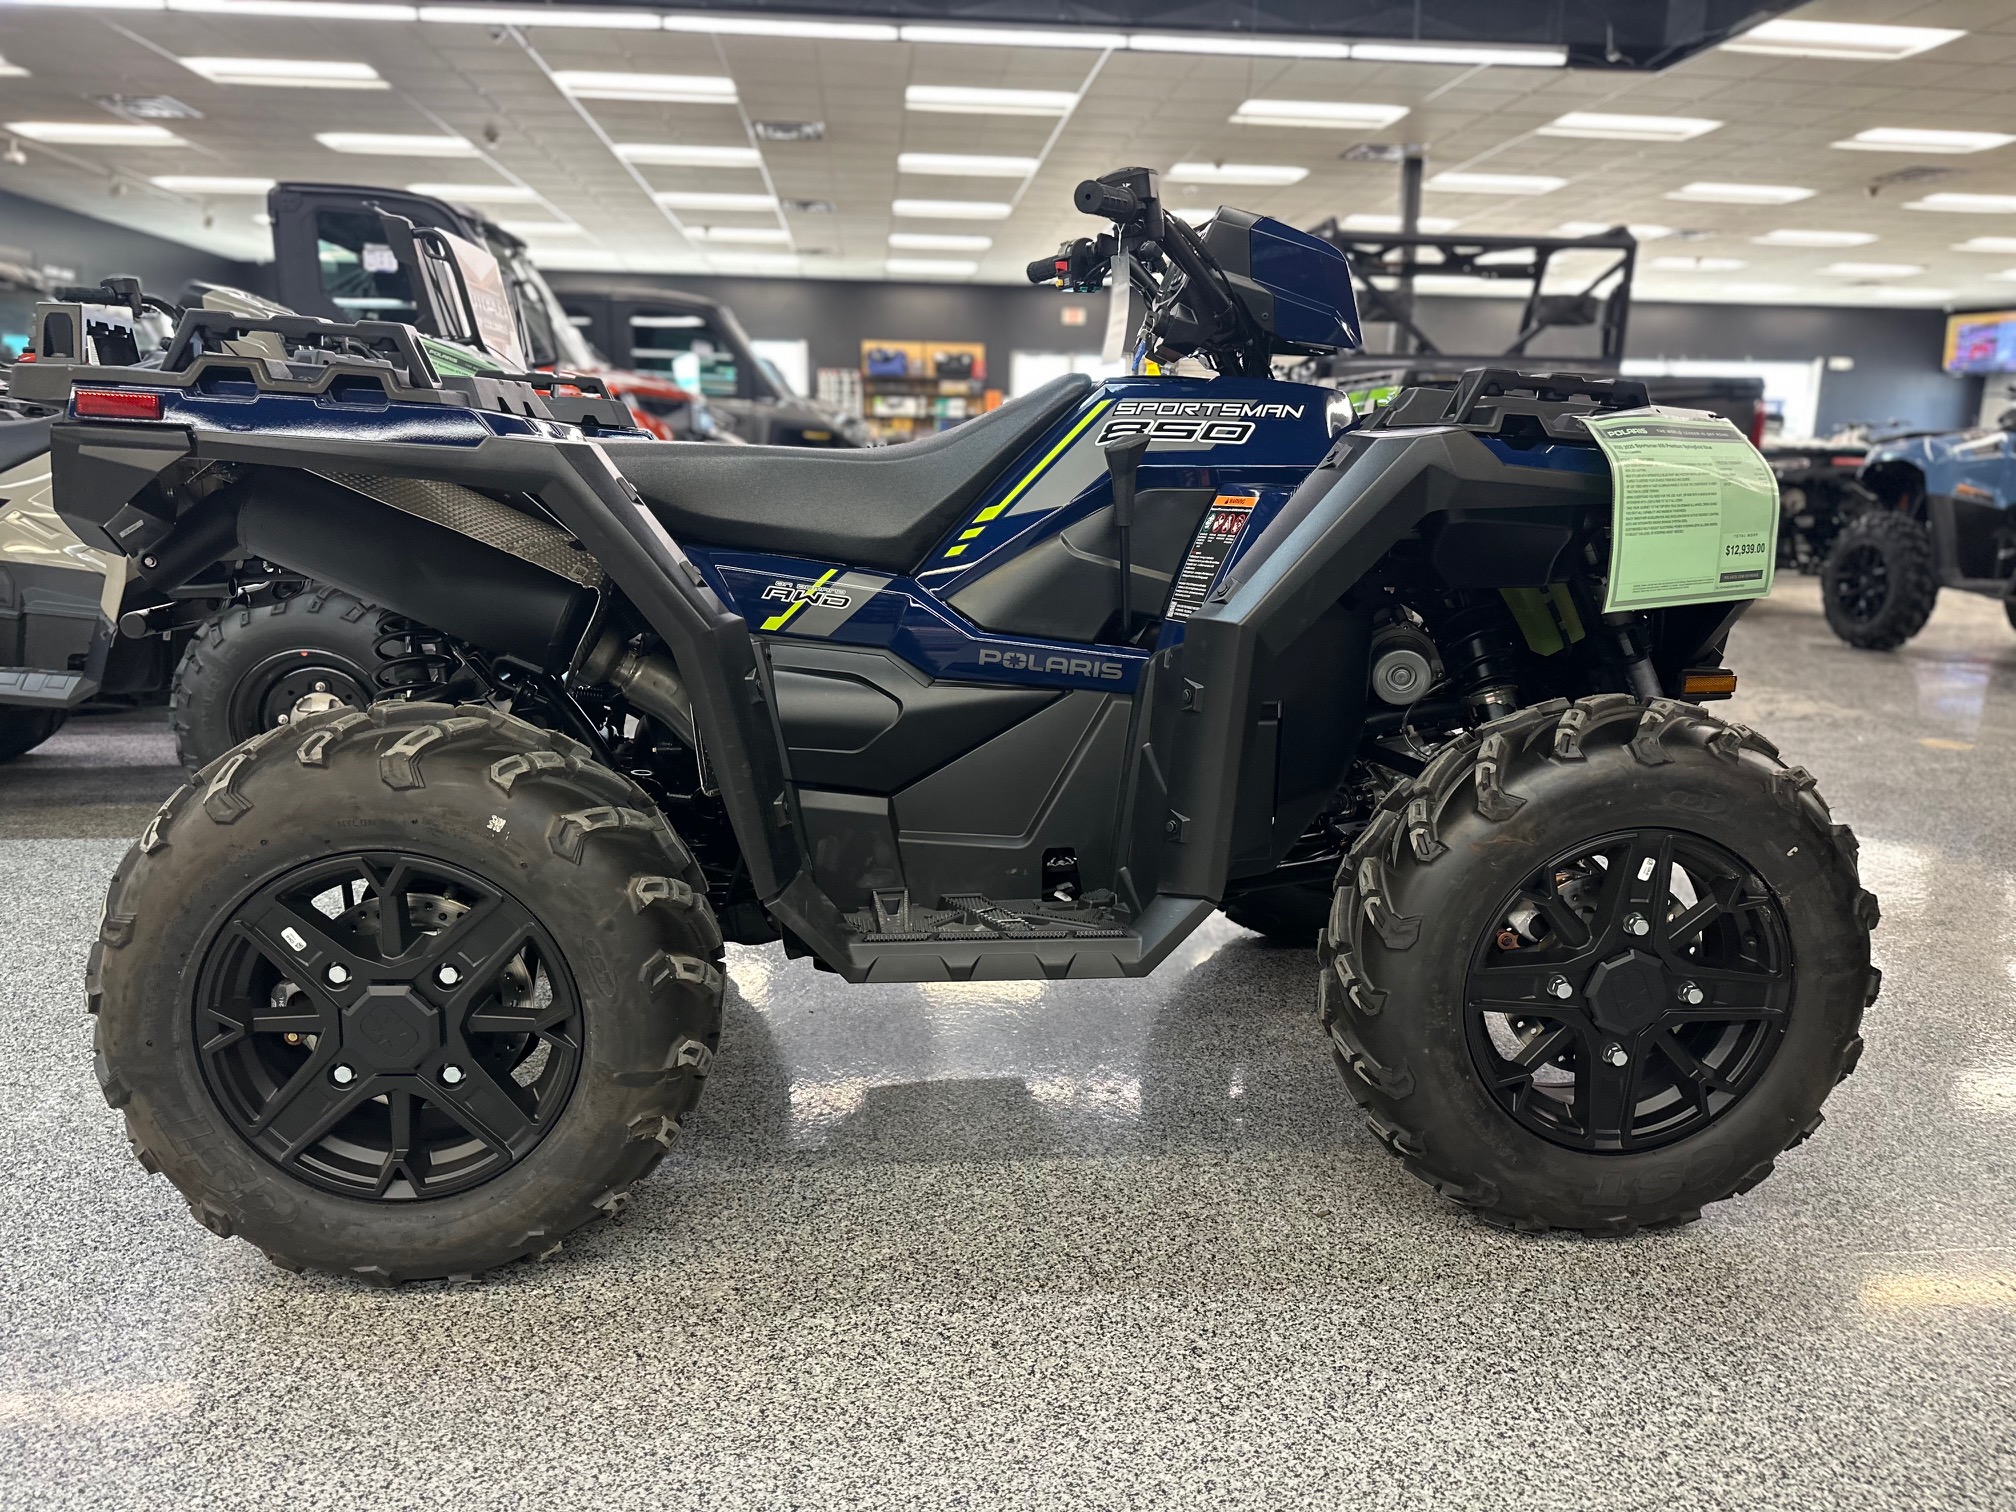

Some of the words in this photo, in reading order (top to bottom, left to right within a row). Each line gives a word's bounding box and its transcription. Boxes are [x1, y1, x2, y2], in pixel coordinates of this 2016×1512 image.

[429, 349, 458, 363] POLARIS
[1113, 402, 1305, 420] SPORTSMAN
[1095, 419, 1255, 446] 850
[1607, 428, 1648, 438] POLARIS
[1725, 542, 1766, 556] $12,939.00
[761, 586, 851, 610] AWD
[978, 649, 1123, 680] POLARIS
